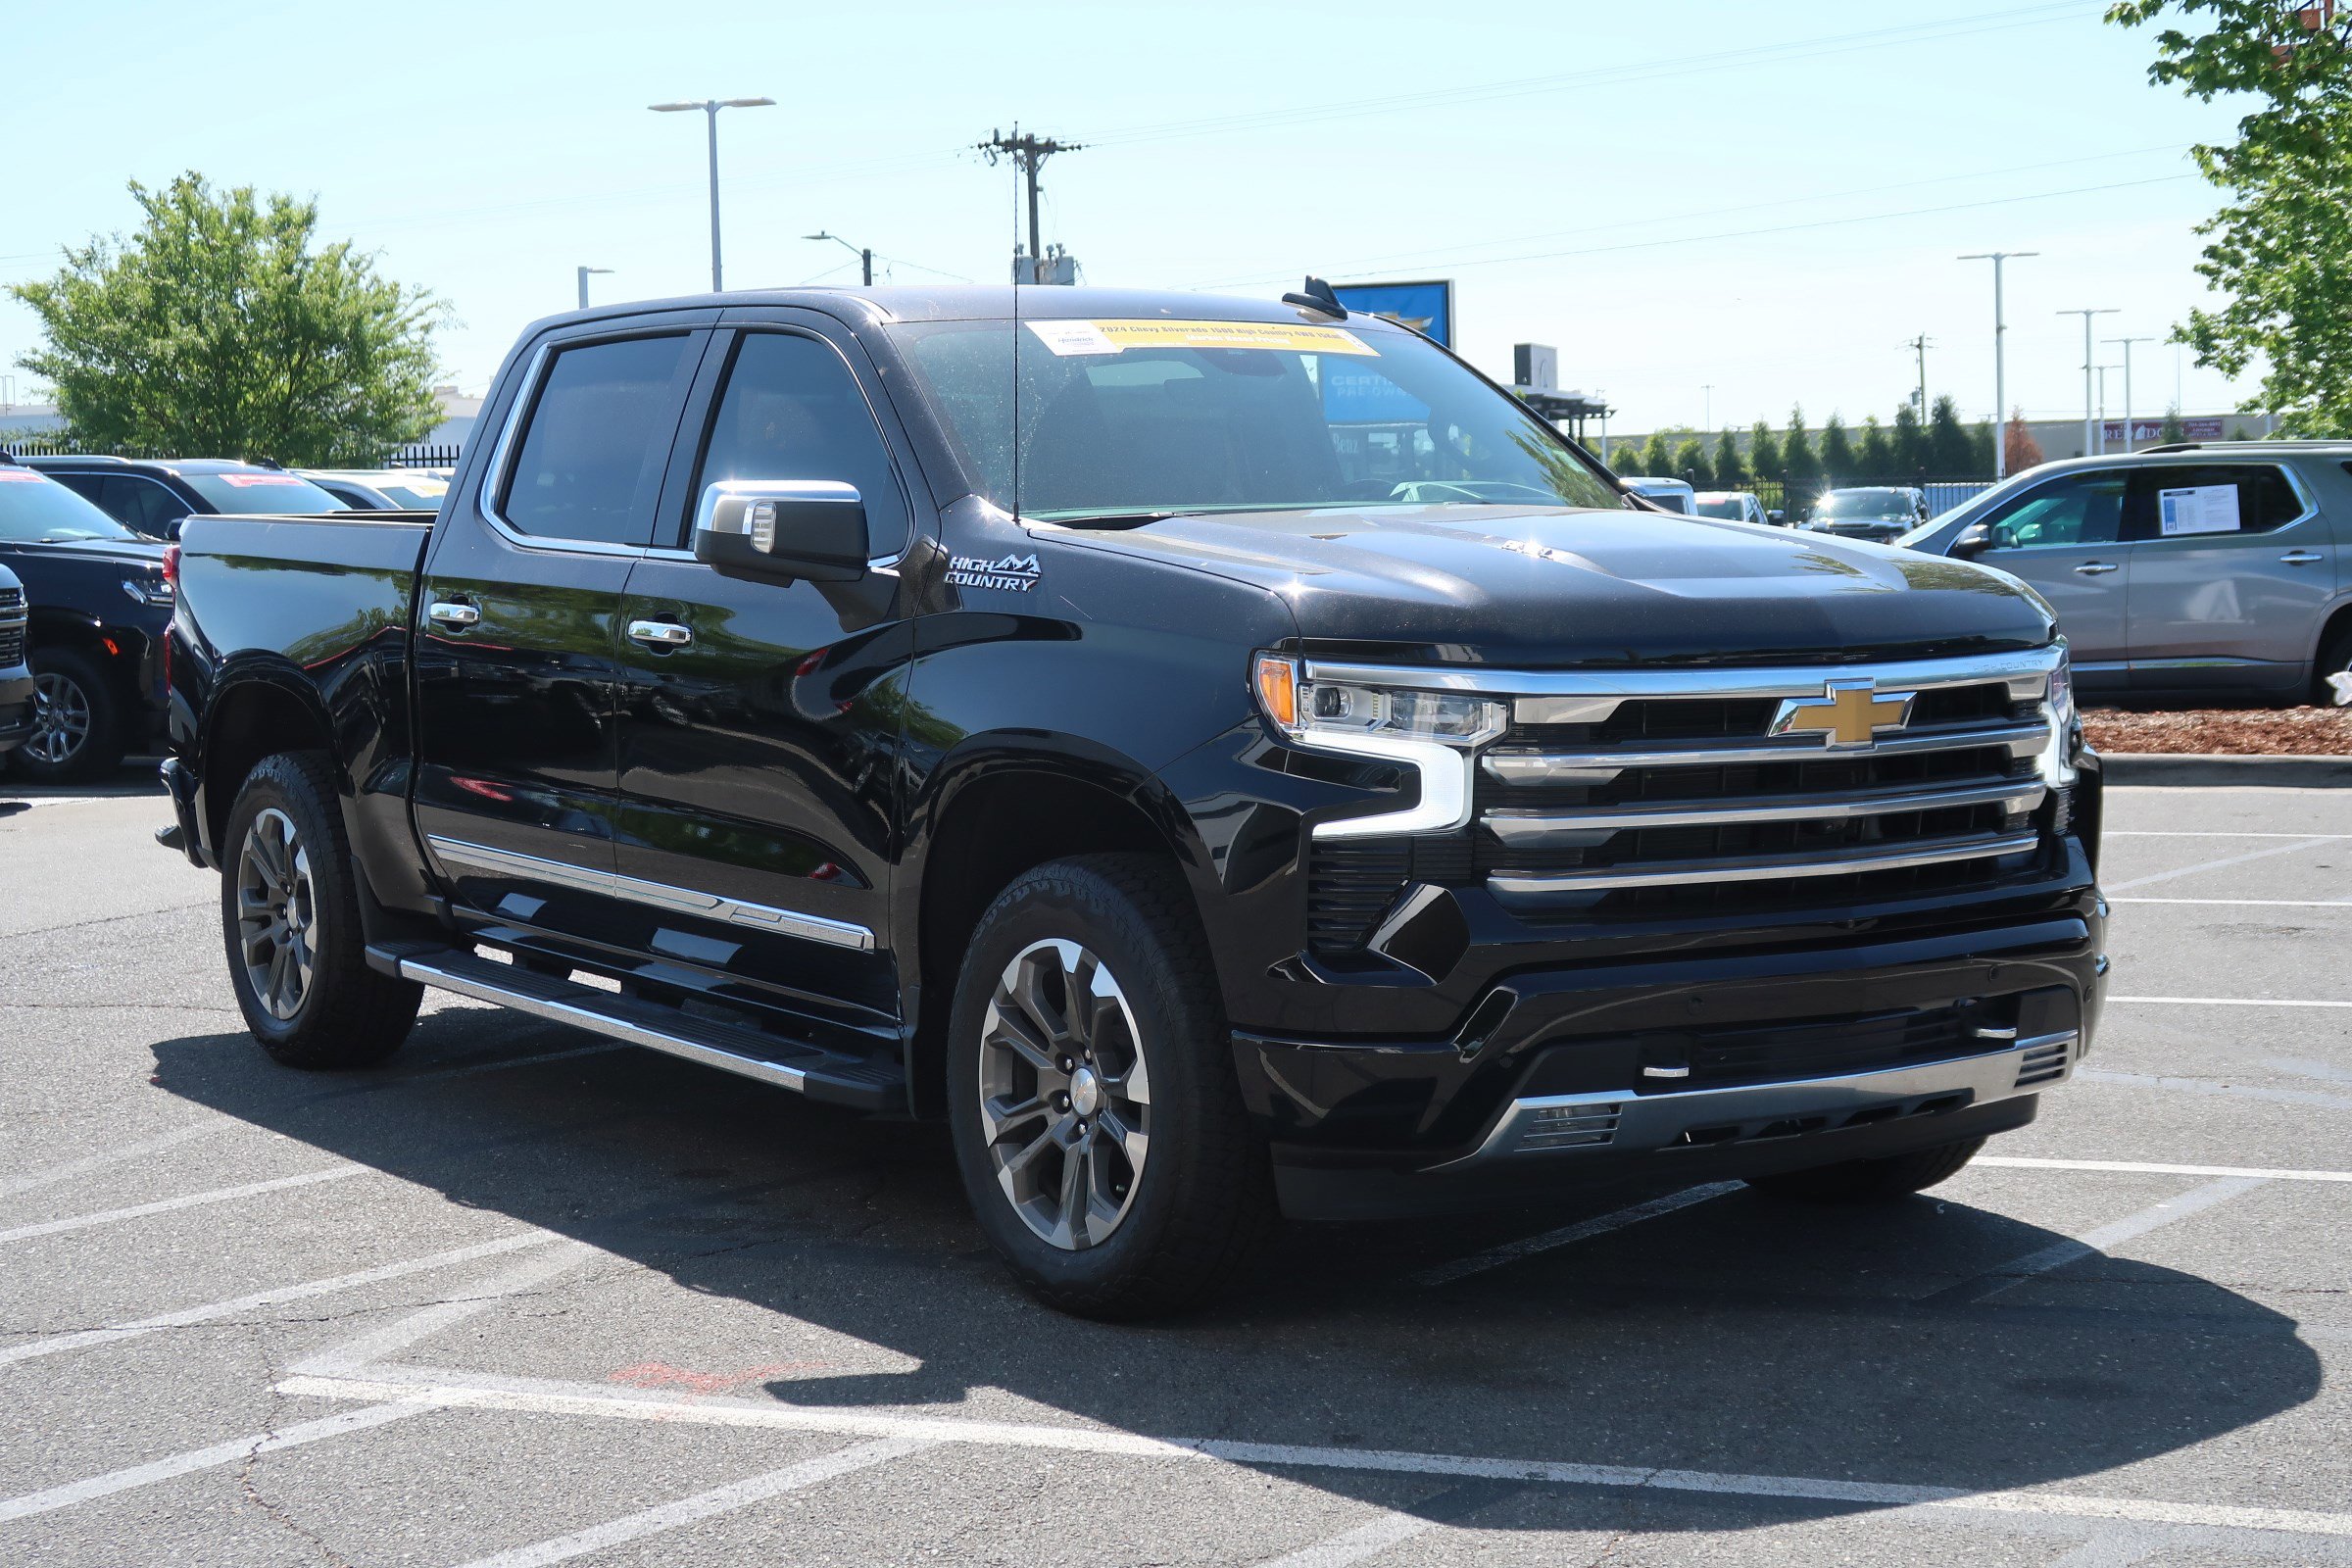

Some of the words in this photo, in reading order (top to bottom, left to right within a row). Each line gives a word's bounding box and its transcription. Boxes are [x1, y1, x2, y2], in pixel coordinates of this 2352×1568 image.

[1130, 325, 1159, 334] Chevy
[950, 557, 995, 572] HIGH
[945, 572, 1038, 593] COUNTRY
[2000, 660, 2044, 670] COUNTRY
